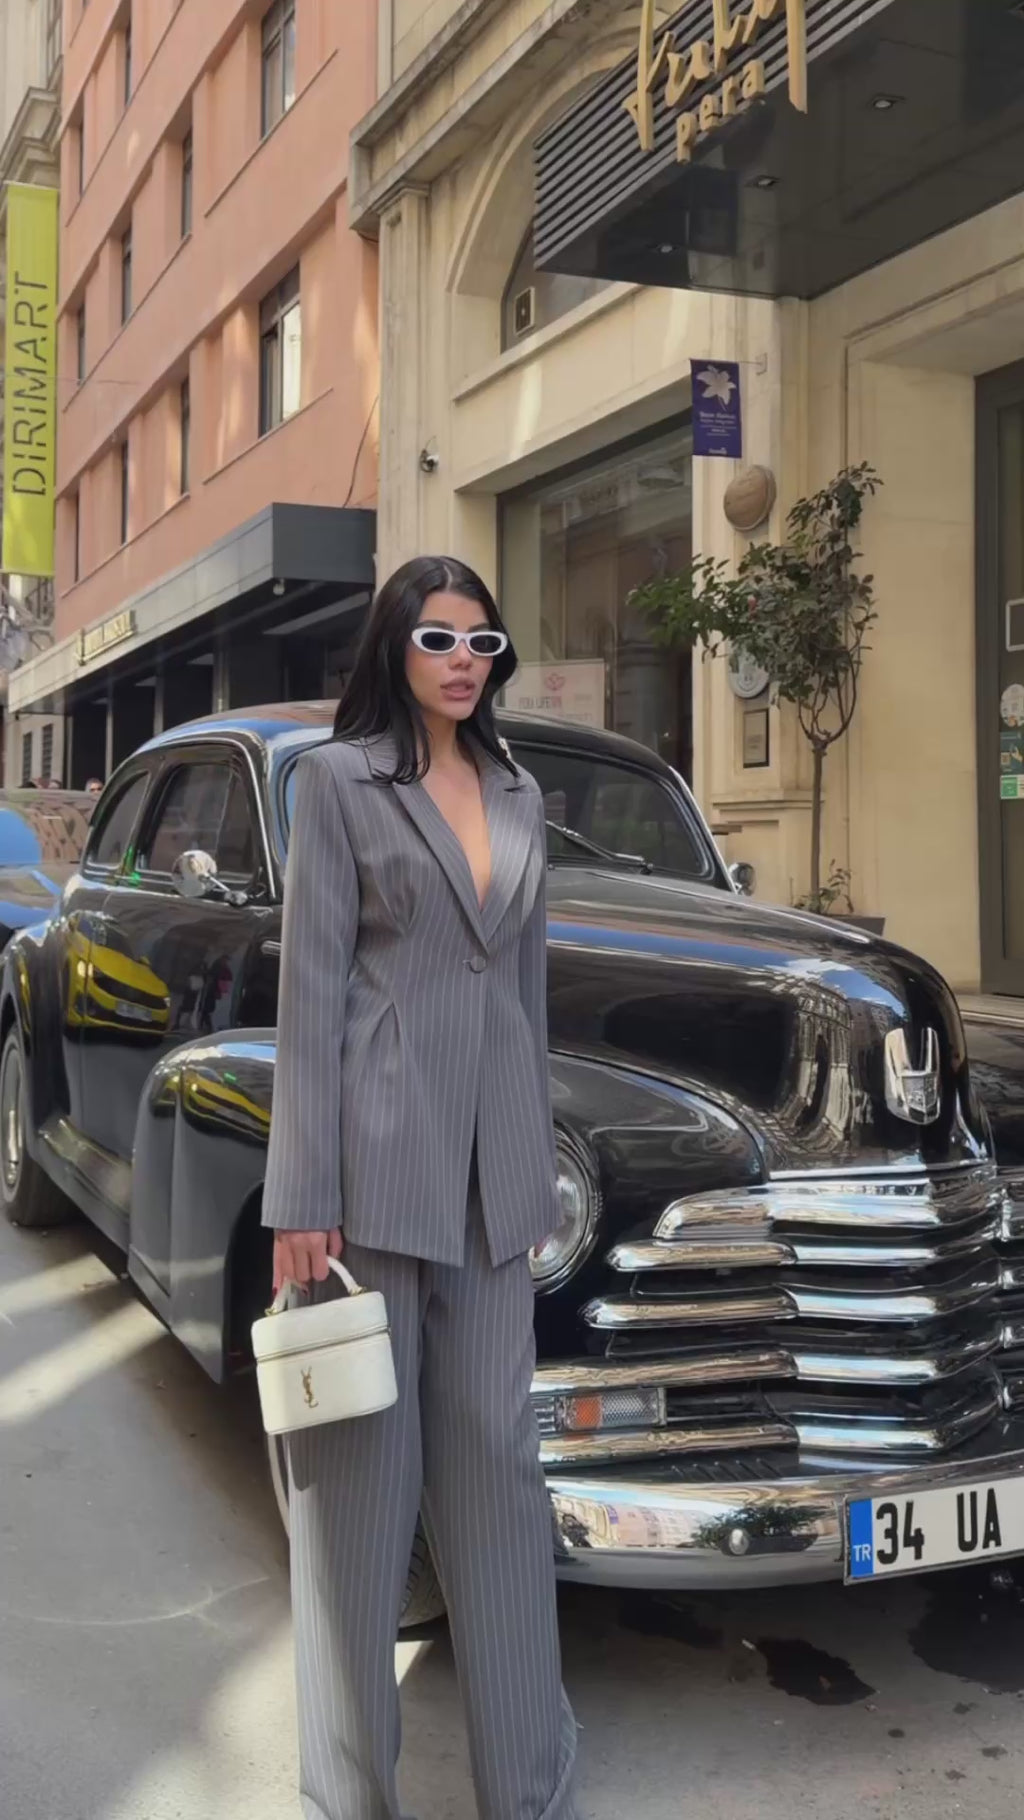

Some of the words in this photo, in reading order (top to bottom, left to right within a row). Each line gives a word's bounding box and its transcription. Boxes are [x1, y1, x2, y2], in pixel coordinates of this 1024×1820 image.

[676, 59, 766, 163] pera
[12, 270, 49, 496] DIRIMART
[852, 1543, 872, 1563] TR
[876, 1500, 925, 1565] 34
[956, 1487, 1002, 1552] UA
